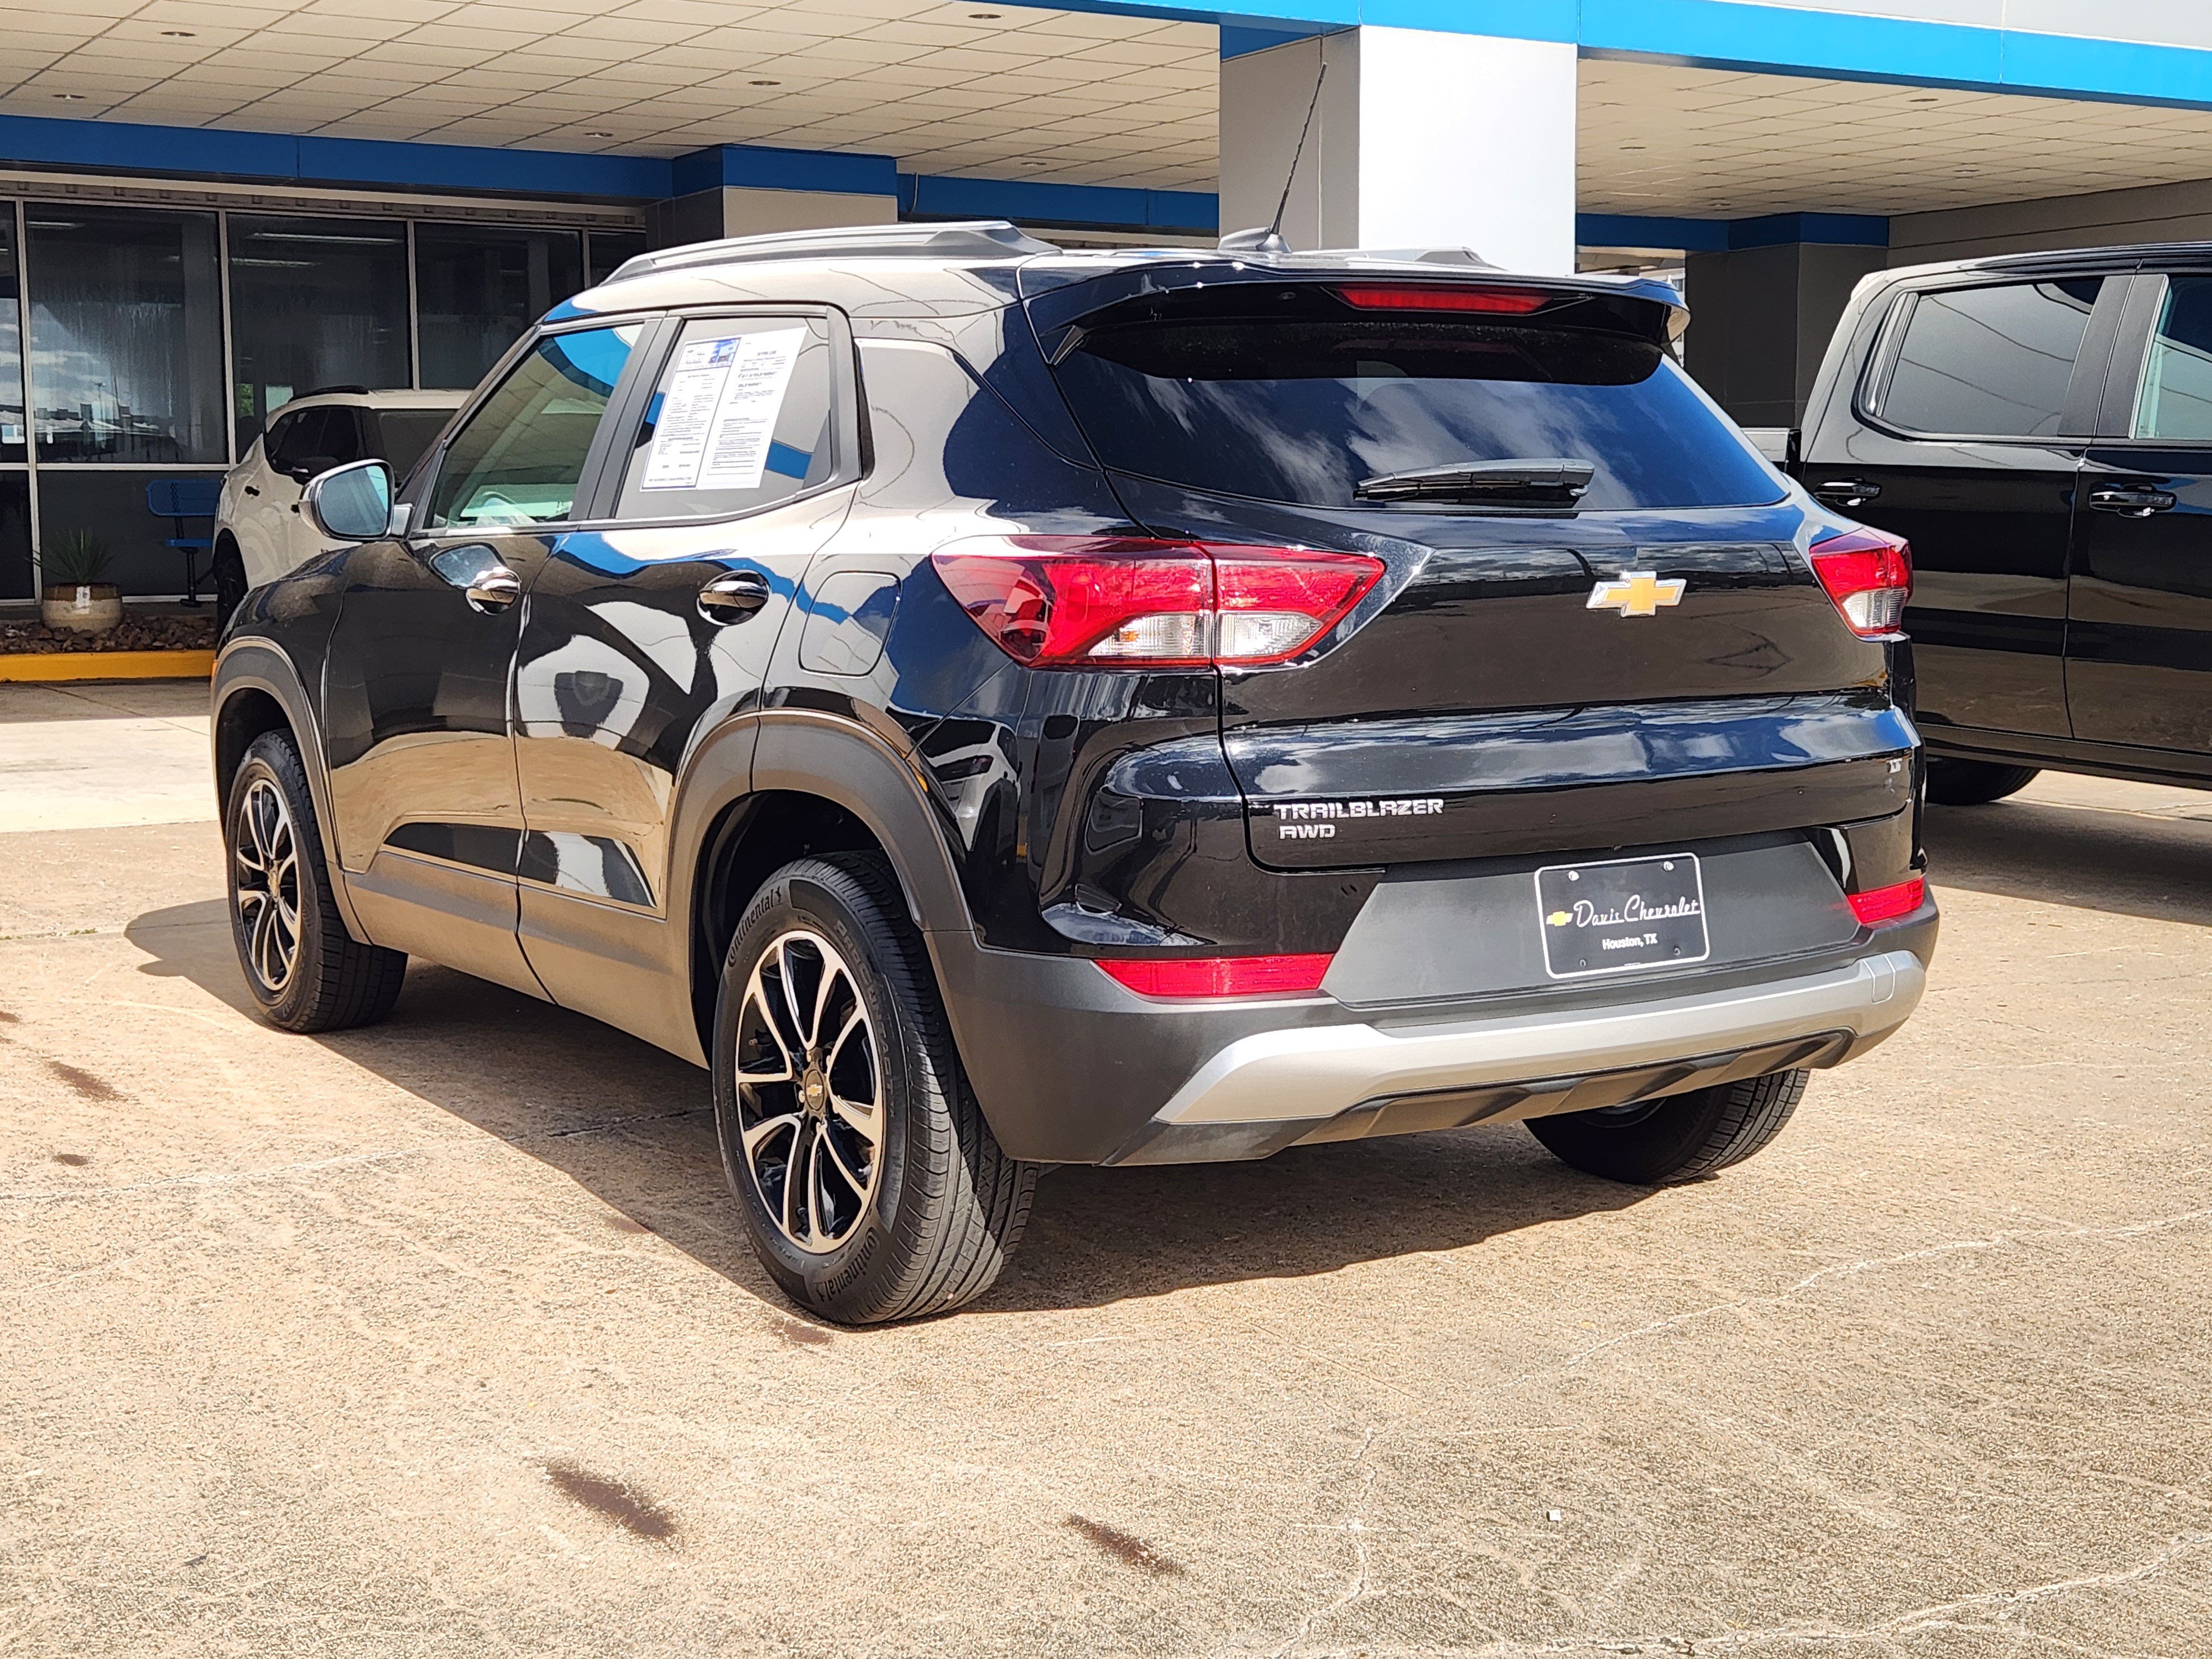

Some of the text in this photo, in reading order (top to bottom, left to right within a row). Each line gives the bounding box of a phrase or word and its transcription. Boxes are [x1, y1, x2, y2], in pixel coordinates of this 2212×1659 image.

[1273, 799, 1443, 820] TRAILBLAZER
[1279, 824, 1335, 839] AWD
[1573, 894, 1701, 927] Davis Chevrolet
[727, 886, 774, 967] Continental
[1602, 932, 1658, 950] Houston, TX
